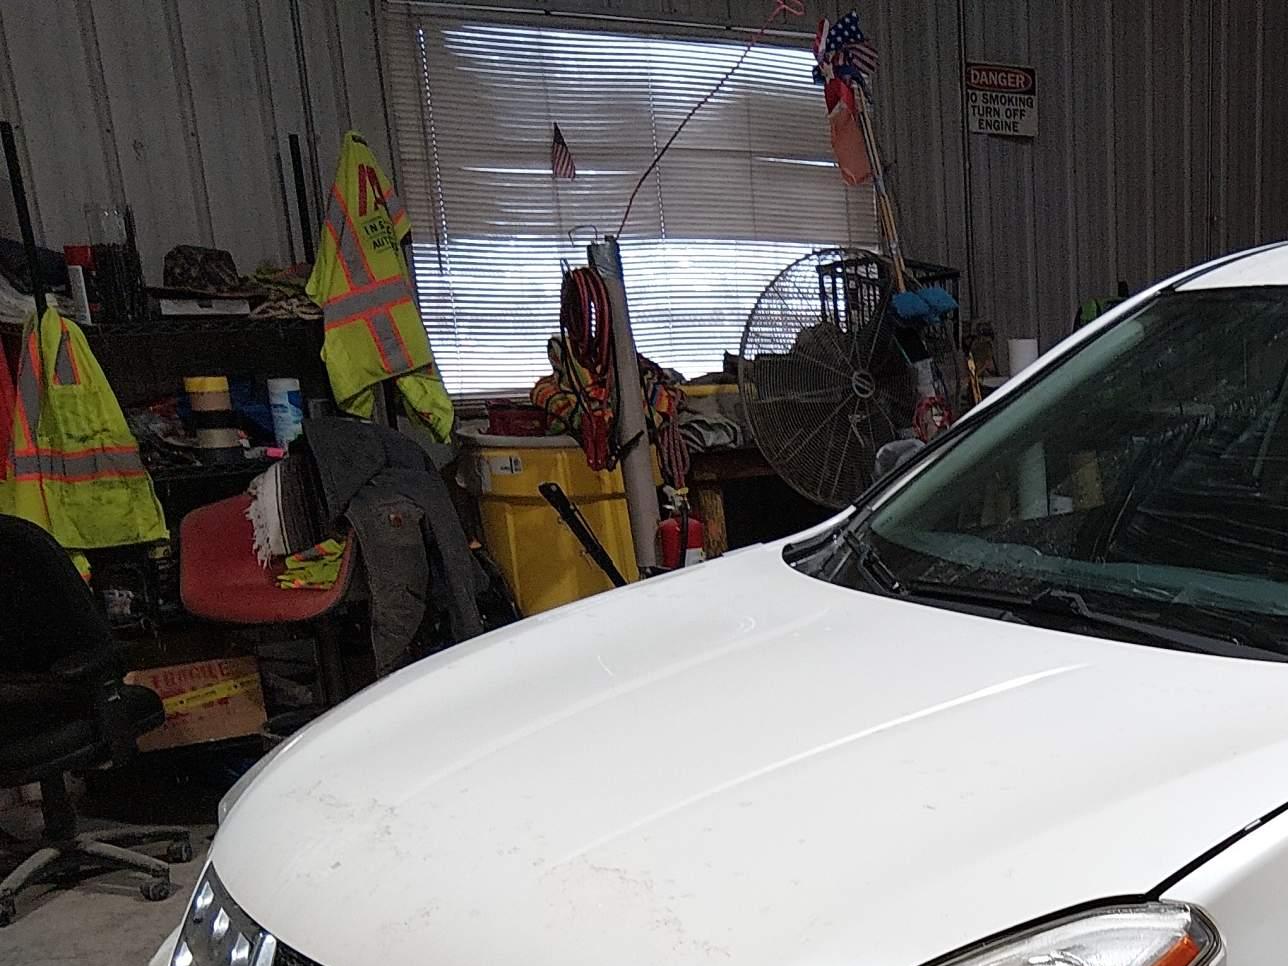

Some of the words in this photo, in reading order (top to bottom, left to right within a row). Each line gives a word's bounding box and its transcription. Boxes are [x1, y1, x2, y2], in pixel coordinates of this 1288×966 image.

[970, 68, 1026, 89] DANGER
[982, 93, 1035, 109] SMOKING
[970, 104, 1000, 118] TURN
[1005, 107, 1026, 121] OFF
[978, 118, 1020, 132] ENGINE
